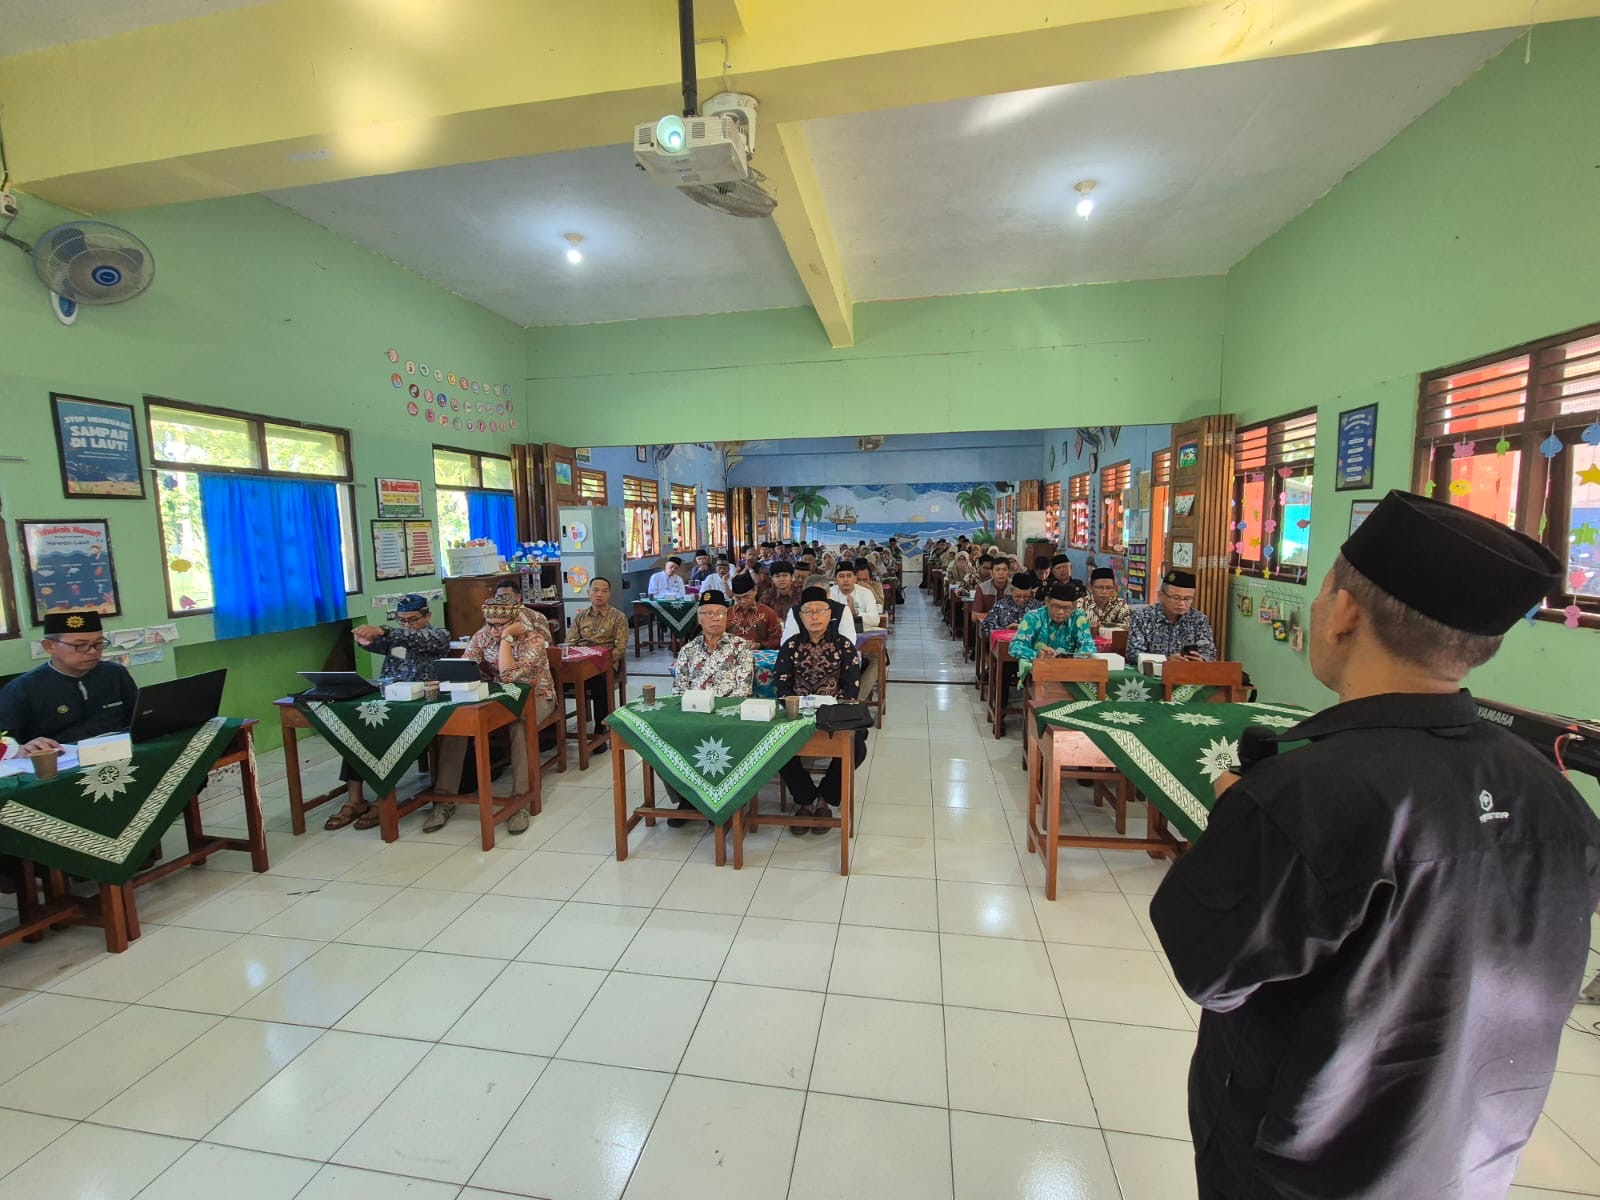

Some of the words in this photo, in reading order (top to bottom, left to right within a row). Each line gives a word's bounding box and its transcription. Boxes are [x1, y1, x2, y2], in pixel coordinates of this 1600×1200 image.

[70, 426, 128, 441] SAMPAH
[70, 437, 88, 448] DI
[90, 438, 129, 452] LAUT!
[1477, 705, 1514, 727] YAMAHA
